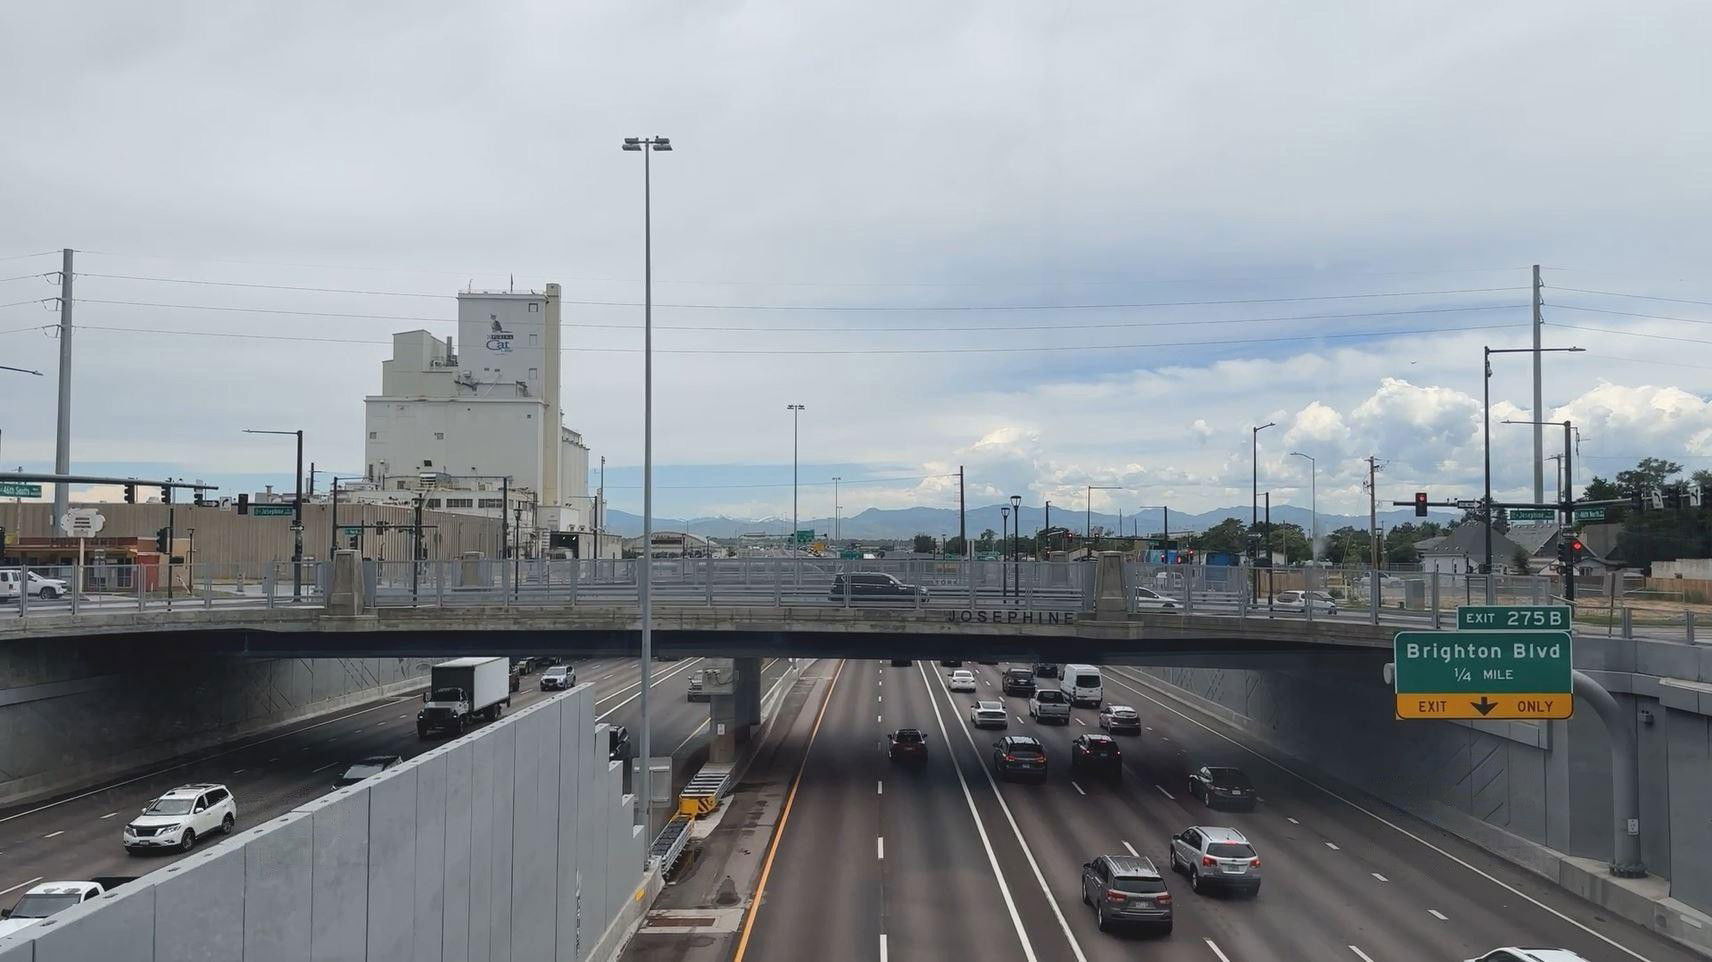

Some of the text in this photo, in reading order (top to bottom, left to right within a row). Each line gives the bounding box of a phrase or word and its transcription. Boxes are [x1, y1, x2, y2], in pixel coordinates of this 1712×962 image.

[947, 610, 1075, 624] JOSEPHINE
[1466, 613, 1495, 624] EXIT
[1407, 643, 1561, 663] Brighton Blvd
[1483, 669, 1514, 680] MILE
[1419, 701, 1553, 713] EXIT ONLY
